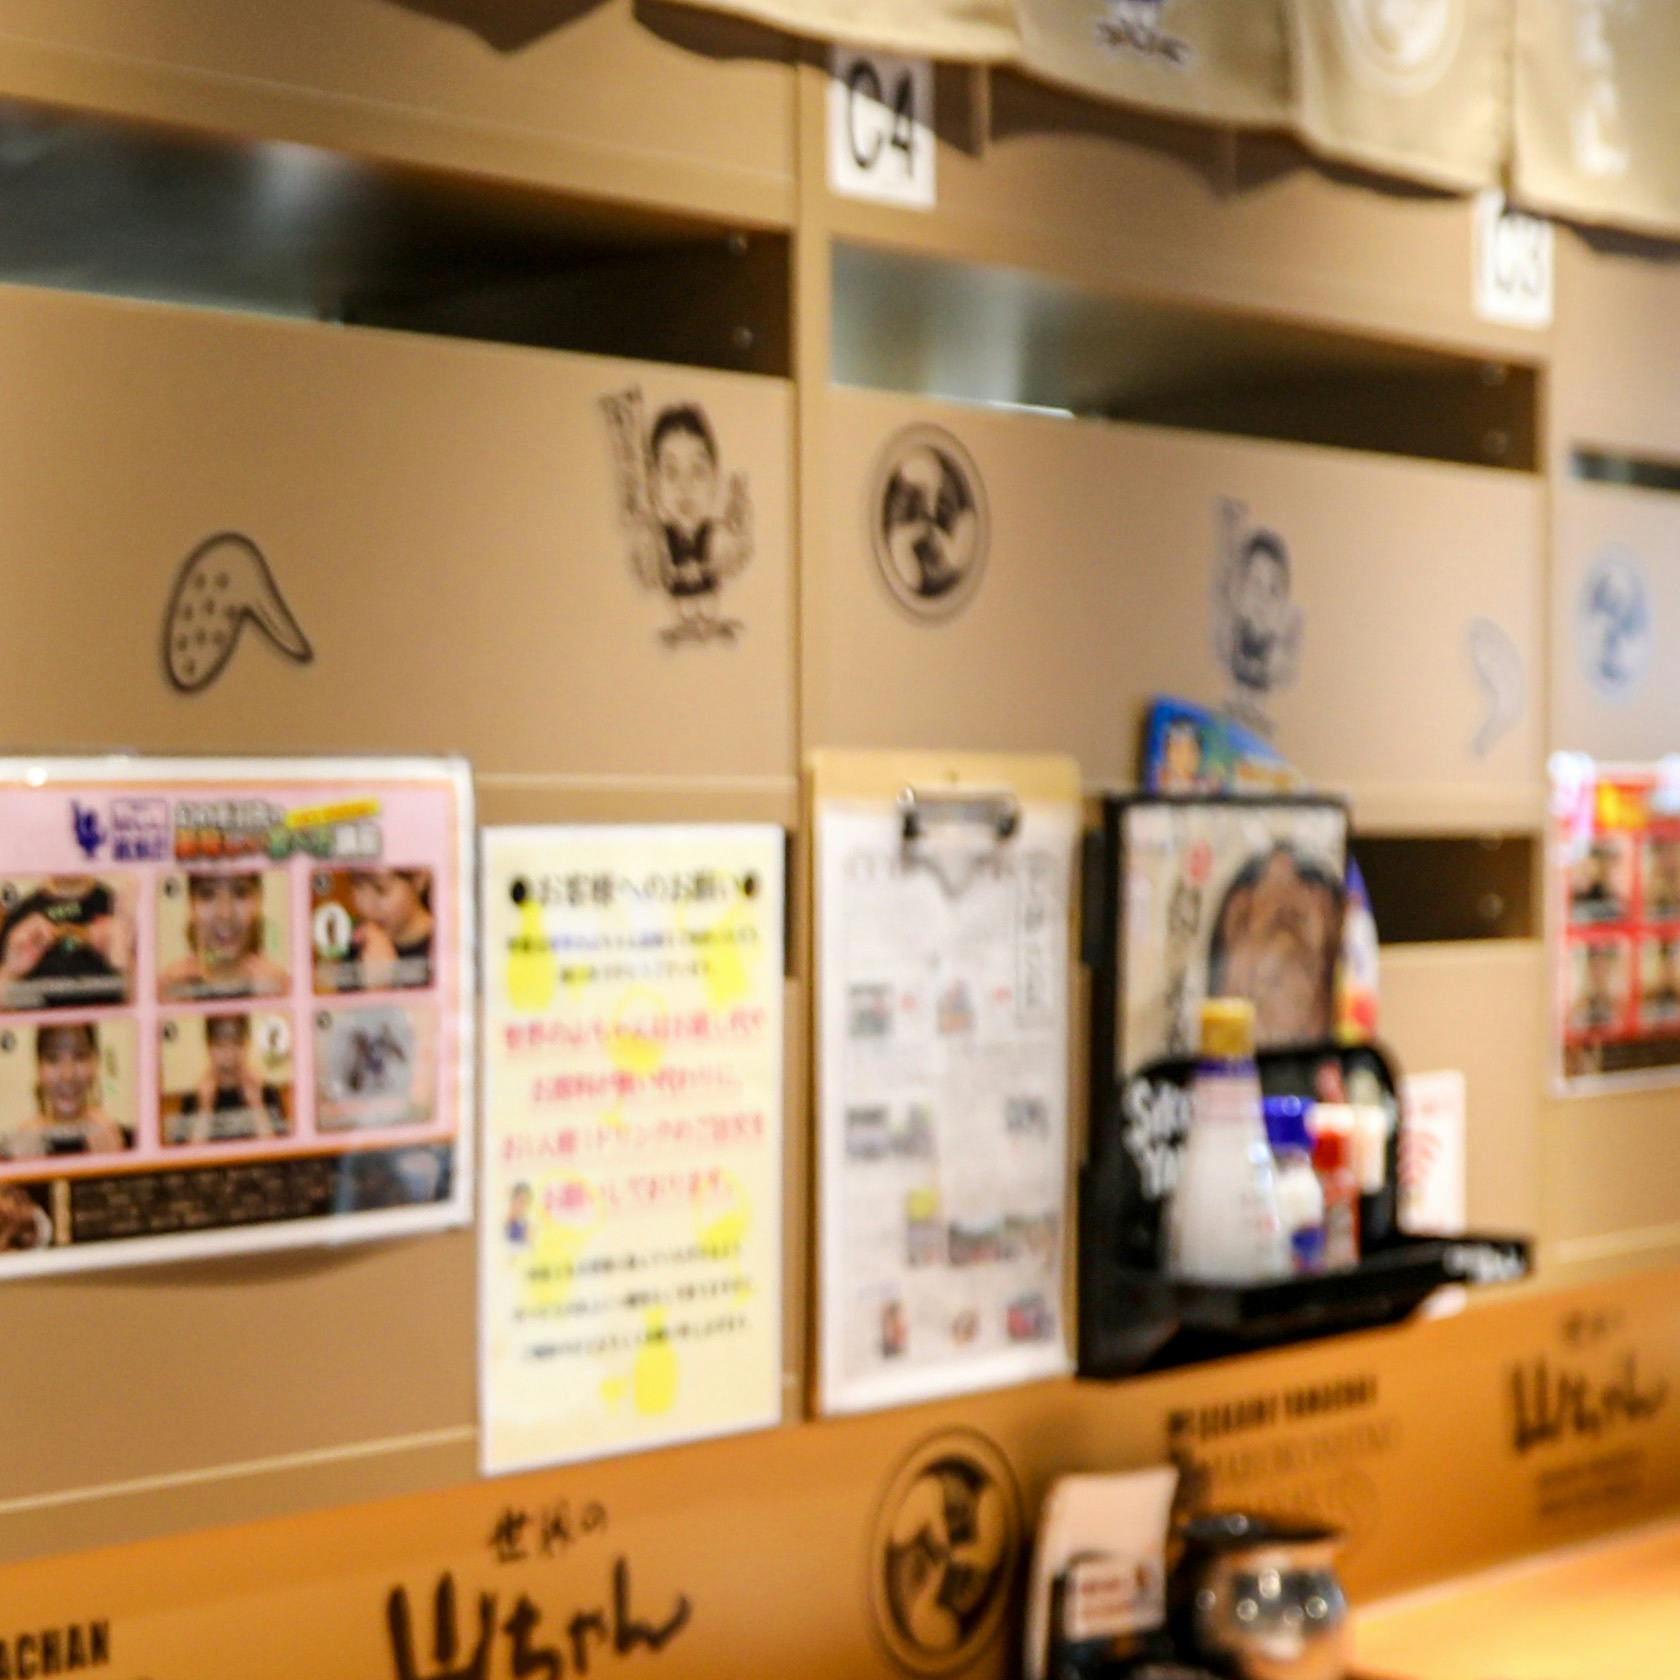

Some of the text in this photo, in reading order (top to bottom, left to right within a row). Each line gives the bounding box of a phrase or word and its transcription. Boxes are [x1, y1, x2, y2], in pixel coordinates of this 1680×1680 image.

[846, 59, 914, 179] C4
[489, 1497, 608, 1565] 世界の
